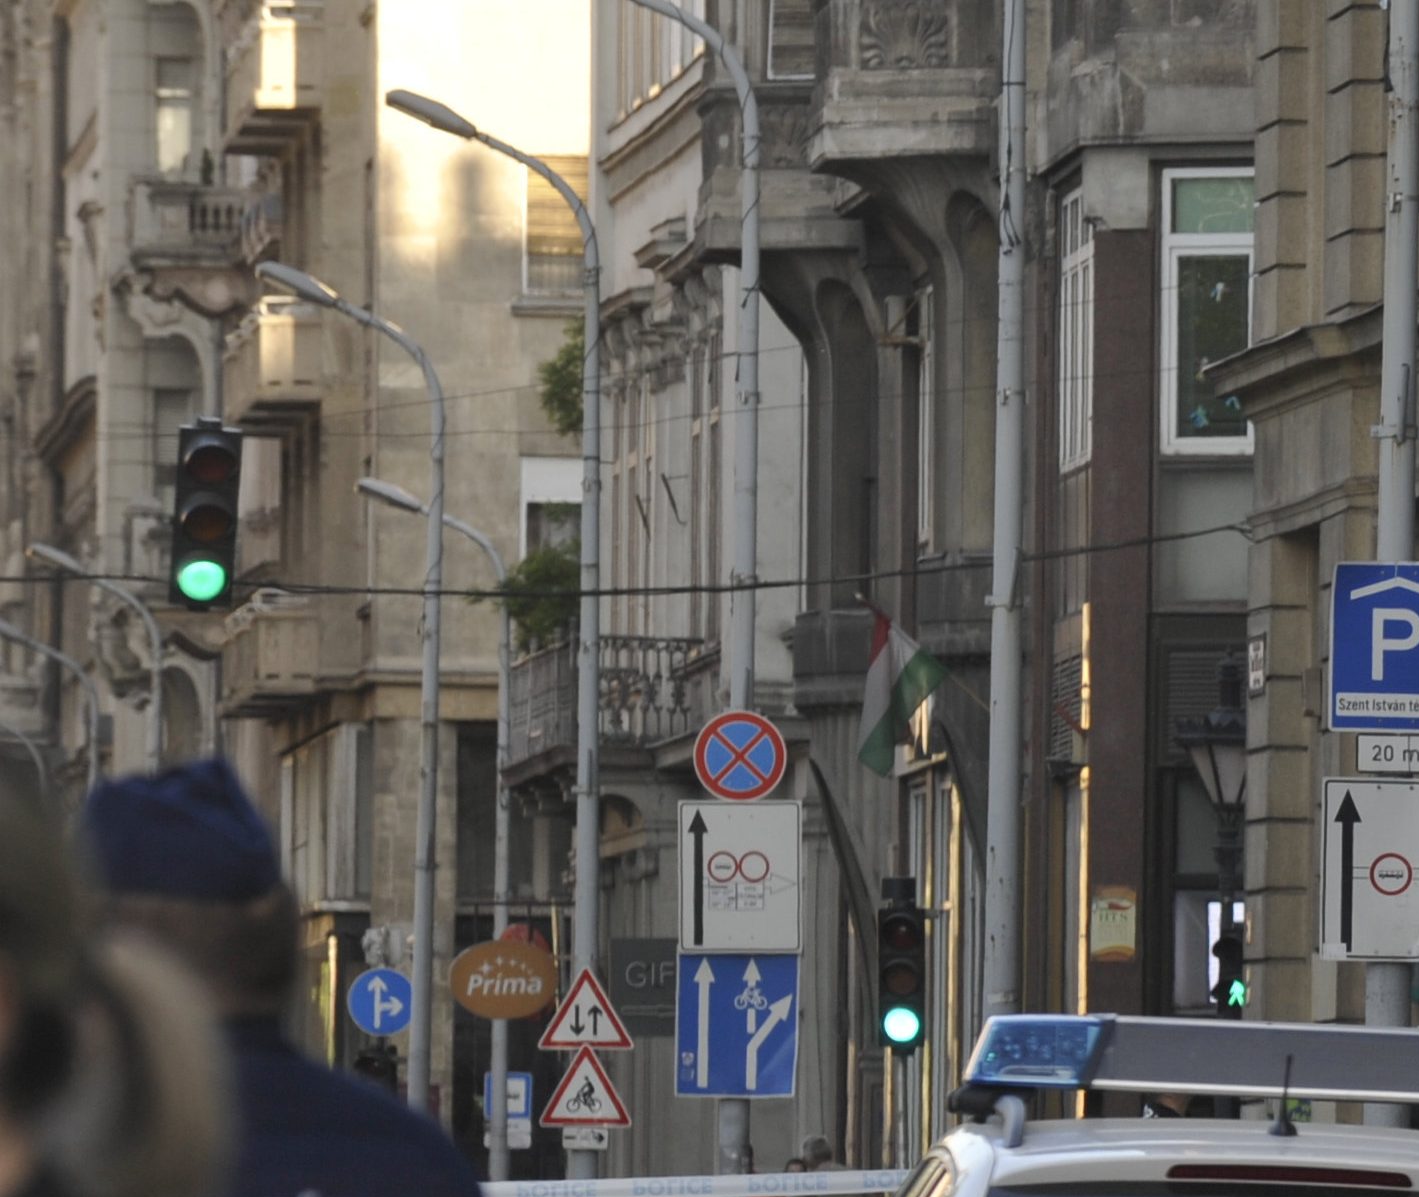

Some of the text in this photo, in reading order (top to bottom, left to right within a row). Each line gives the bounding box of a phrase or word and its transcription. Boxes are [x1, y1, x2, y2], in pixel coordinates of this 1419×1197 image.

[1338, 698, 1369, 712] Szent
[1372, 698, 1405, 713] István
[1372, 744, 1419, 762] 20 m
